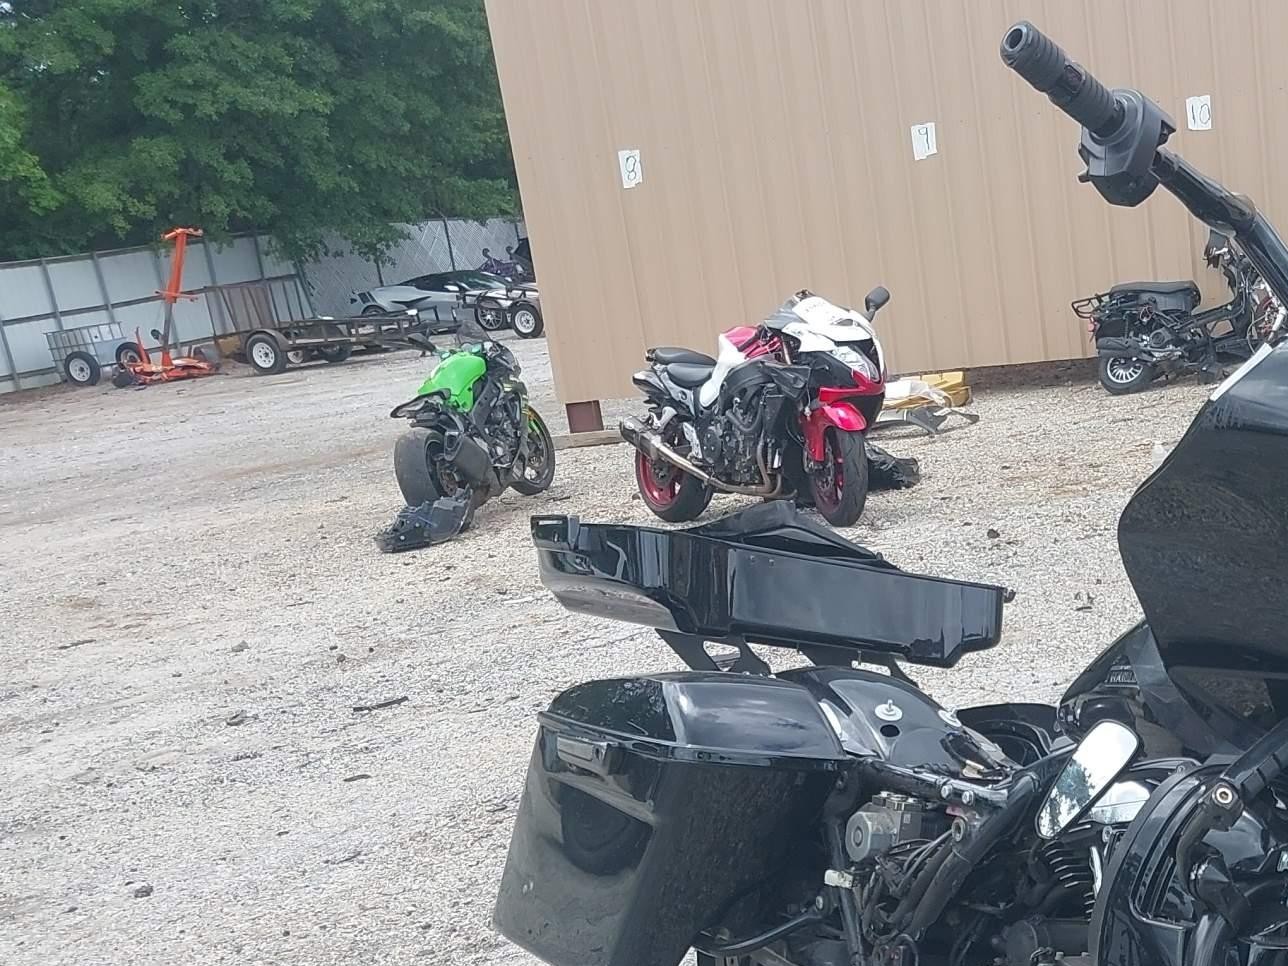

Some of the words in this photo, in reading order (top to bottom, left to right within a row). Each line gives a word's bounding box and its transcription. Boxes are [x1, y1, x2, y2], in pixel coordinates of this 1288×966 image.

[1191, 103, 1211, 125] 10
[917, 126, 930, 151] 9
[625, 155, 637, 181] 8
